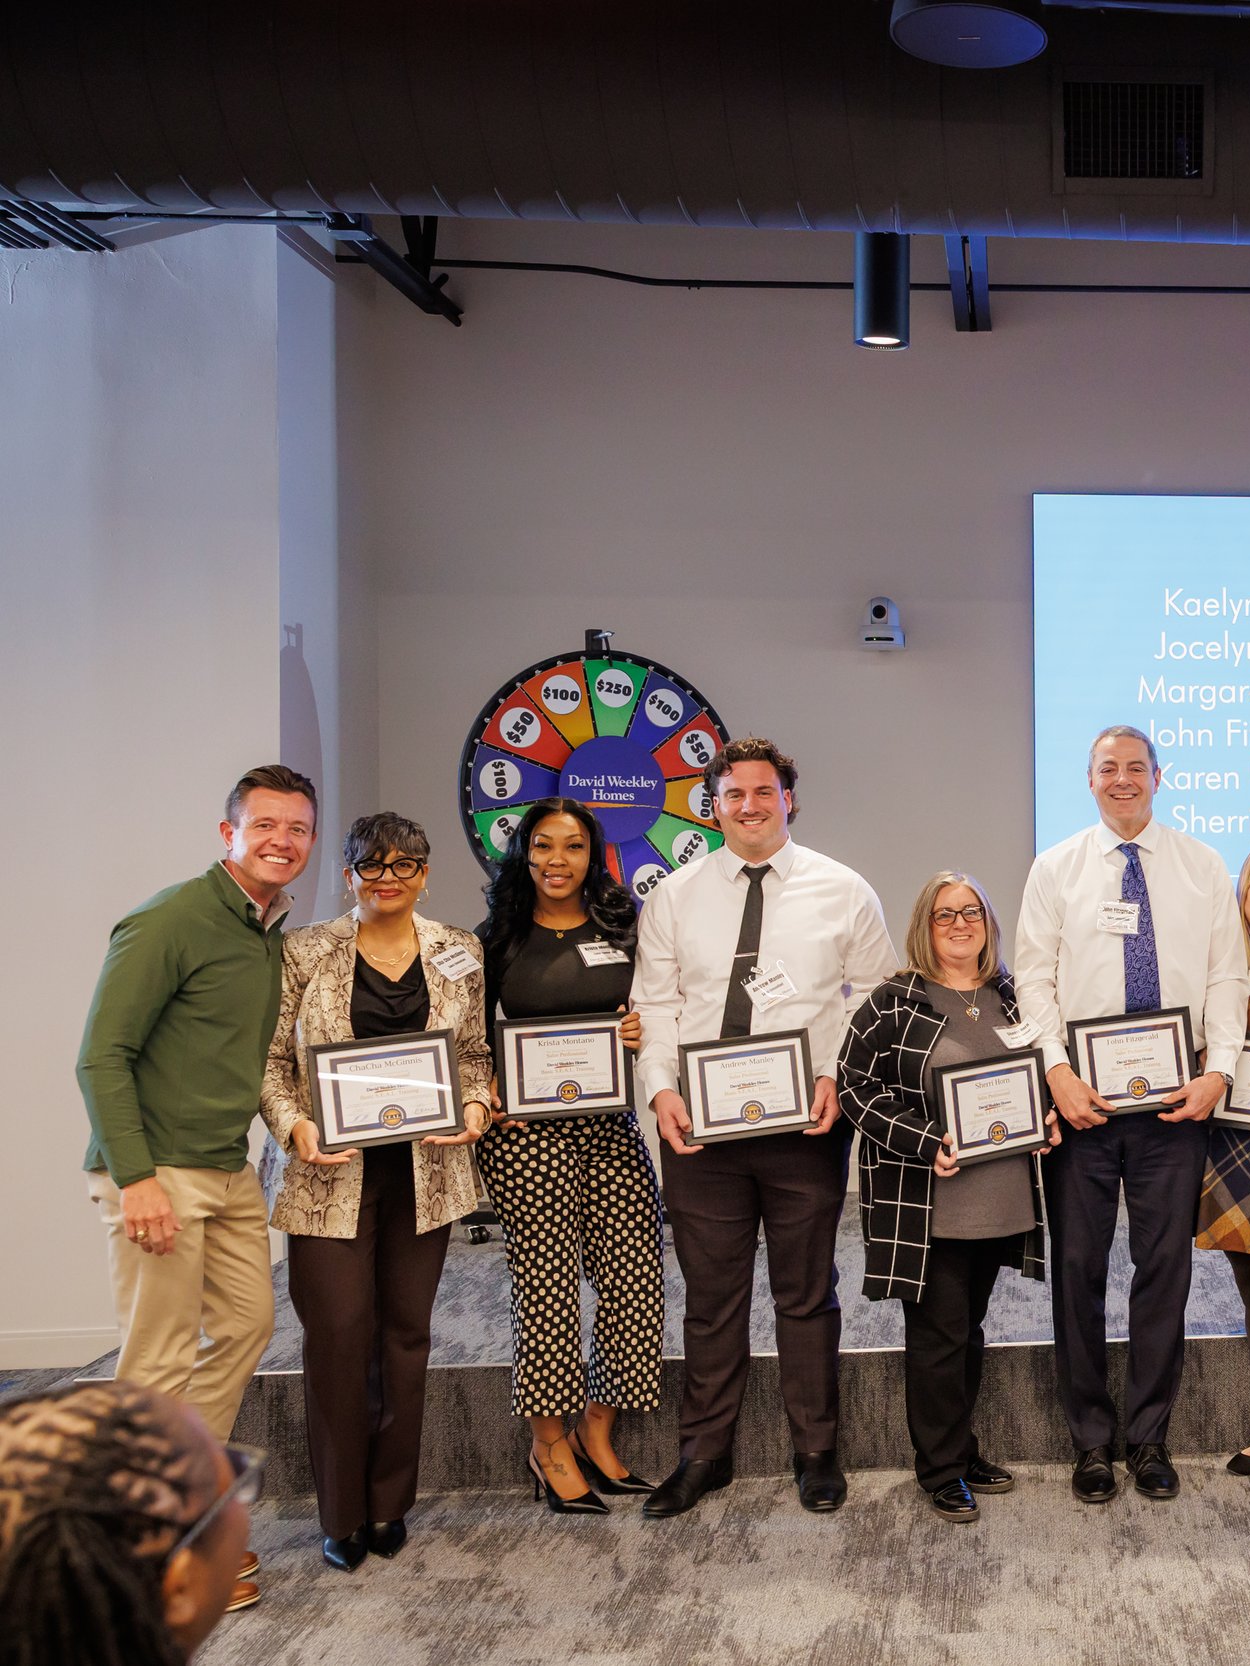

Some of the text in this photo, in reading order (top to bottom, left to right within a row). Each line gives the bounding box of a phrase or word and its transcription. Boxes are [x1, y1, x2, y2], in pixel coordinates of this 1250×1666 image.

[543, 687, 580, 702] $100
[596, 679, 632, 696] $250
[648, 695, 680, 722] $100
[506, 711, 534, 744] $50
[685, 733, 710, 762] $50
[492, 761, 506, 797] $100
[568, 775, 658, 790] David Weekley
[593, 789, 634, 801] Homes
[678, 833, 704, 865] $250
[538, 1037, 595, 1047] Krista Montano
[1107, 1033, 1159, 1046] John Fitzgerald
[349, 1057, 423, 1073] ChaCha McGinnis
[720, 1056, 775, 1070] Andrew Manley
[975, 1078, 1010, 1089] Sherri Horn
